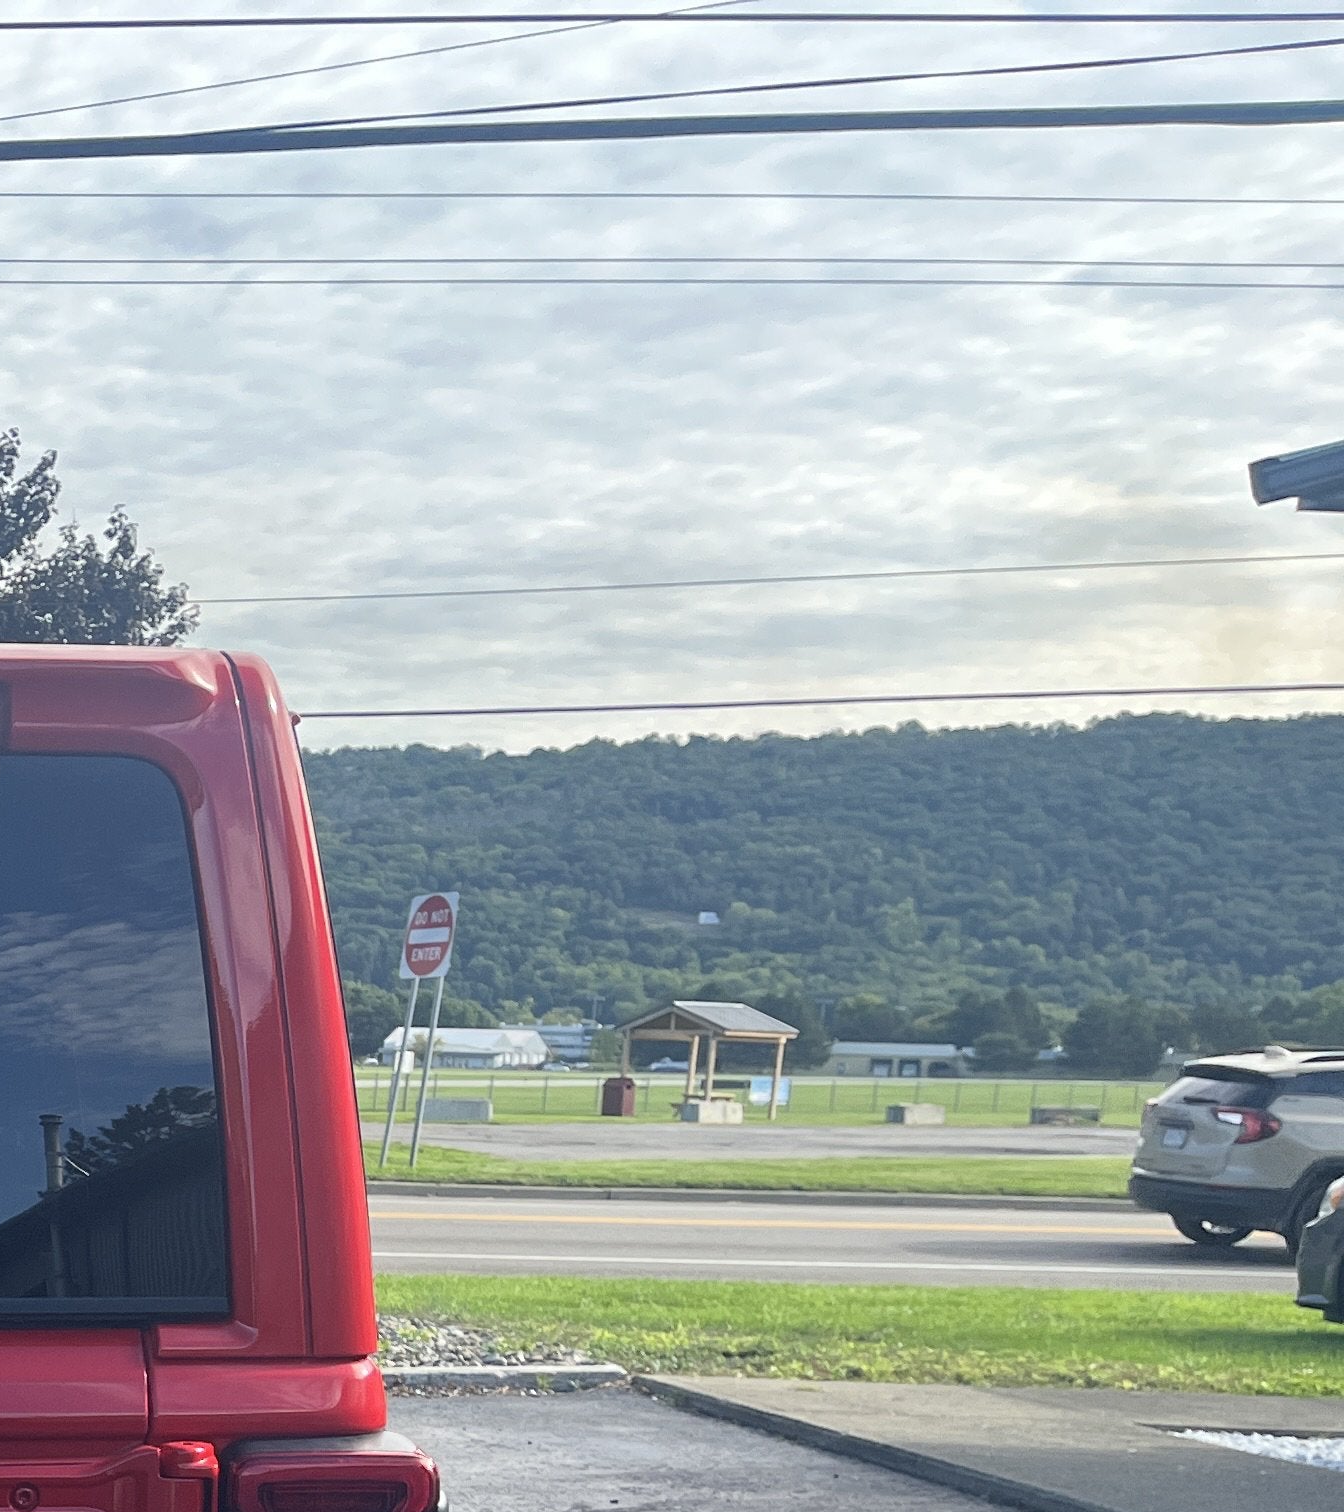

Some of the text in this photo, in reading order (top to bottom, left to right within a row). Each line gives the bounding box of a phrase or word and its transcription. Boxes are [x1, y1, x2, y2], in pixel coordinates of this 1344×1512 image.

[414, 908, 450, 926] DO NOT
[411, 947, 441, 962] ENTER
